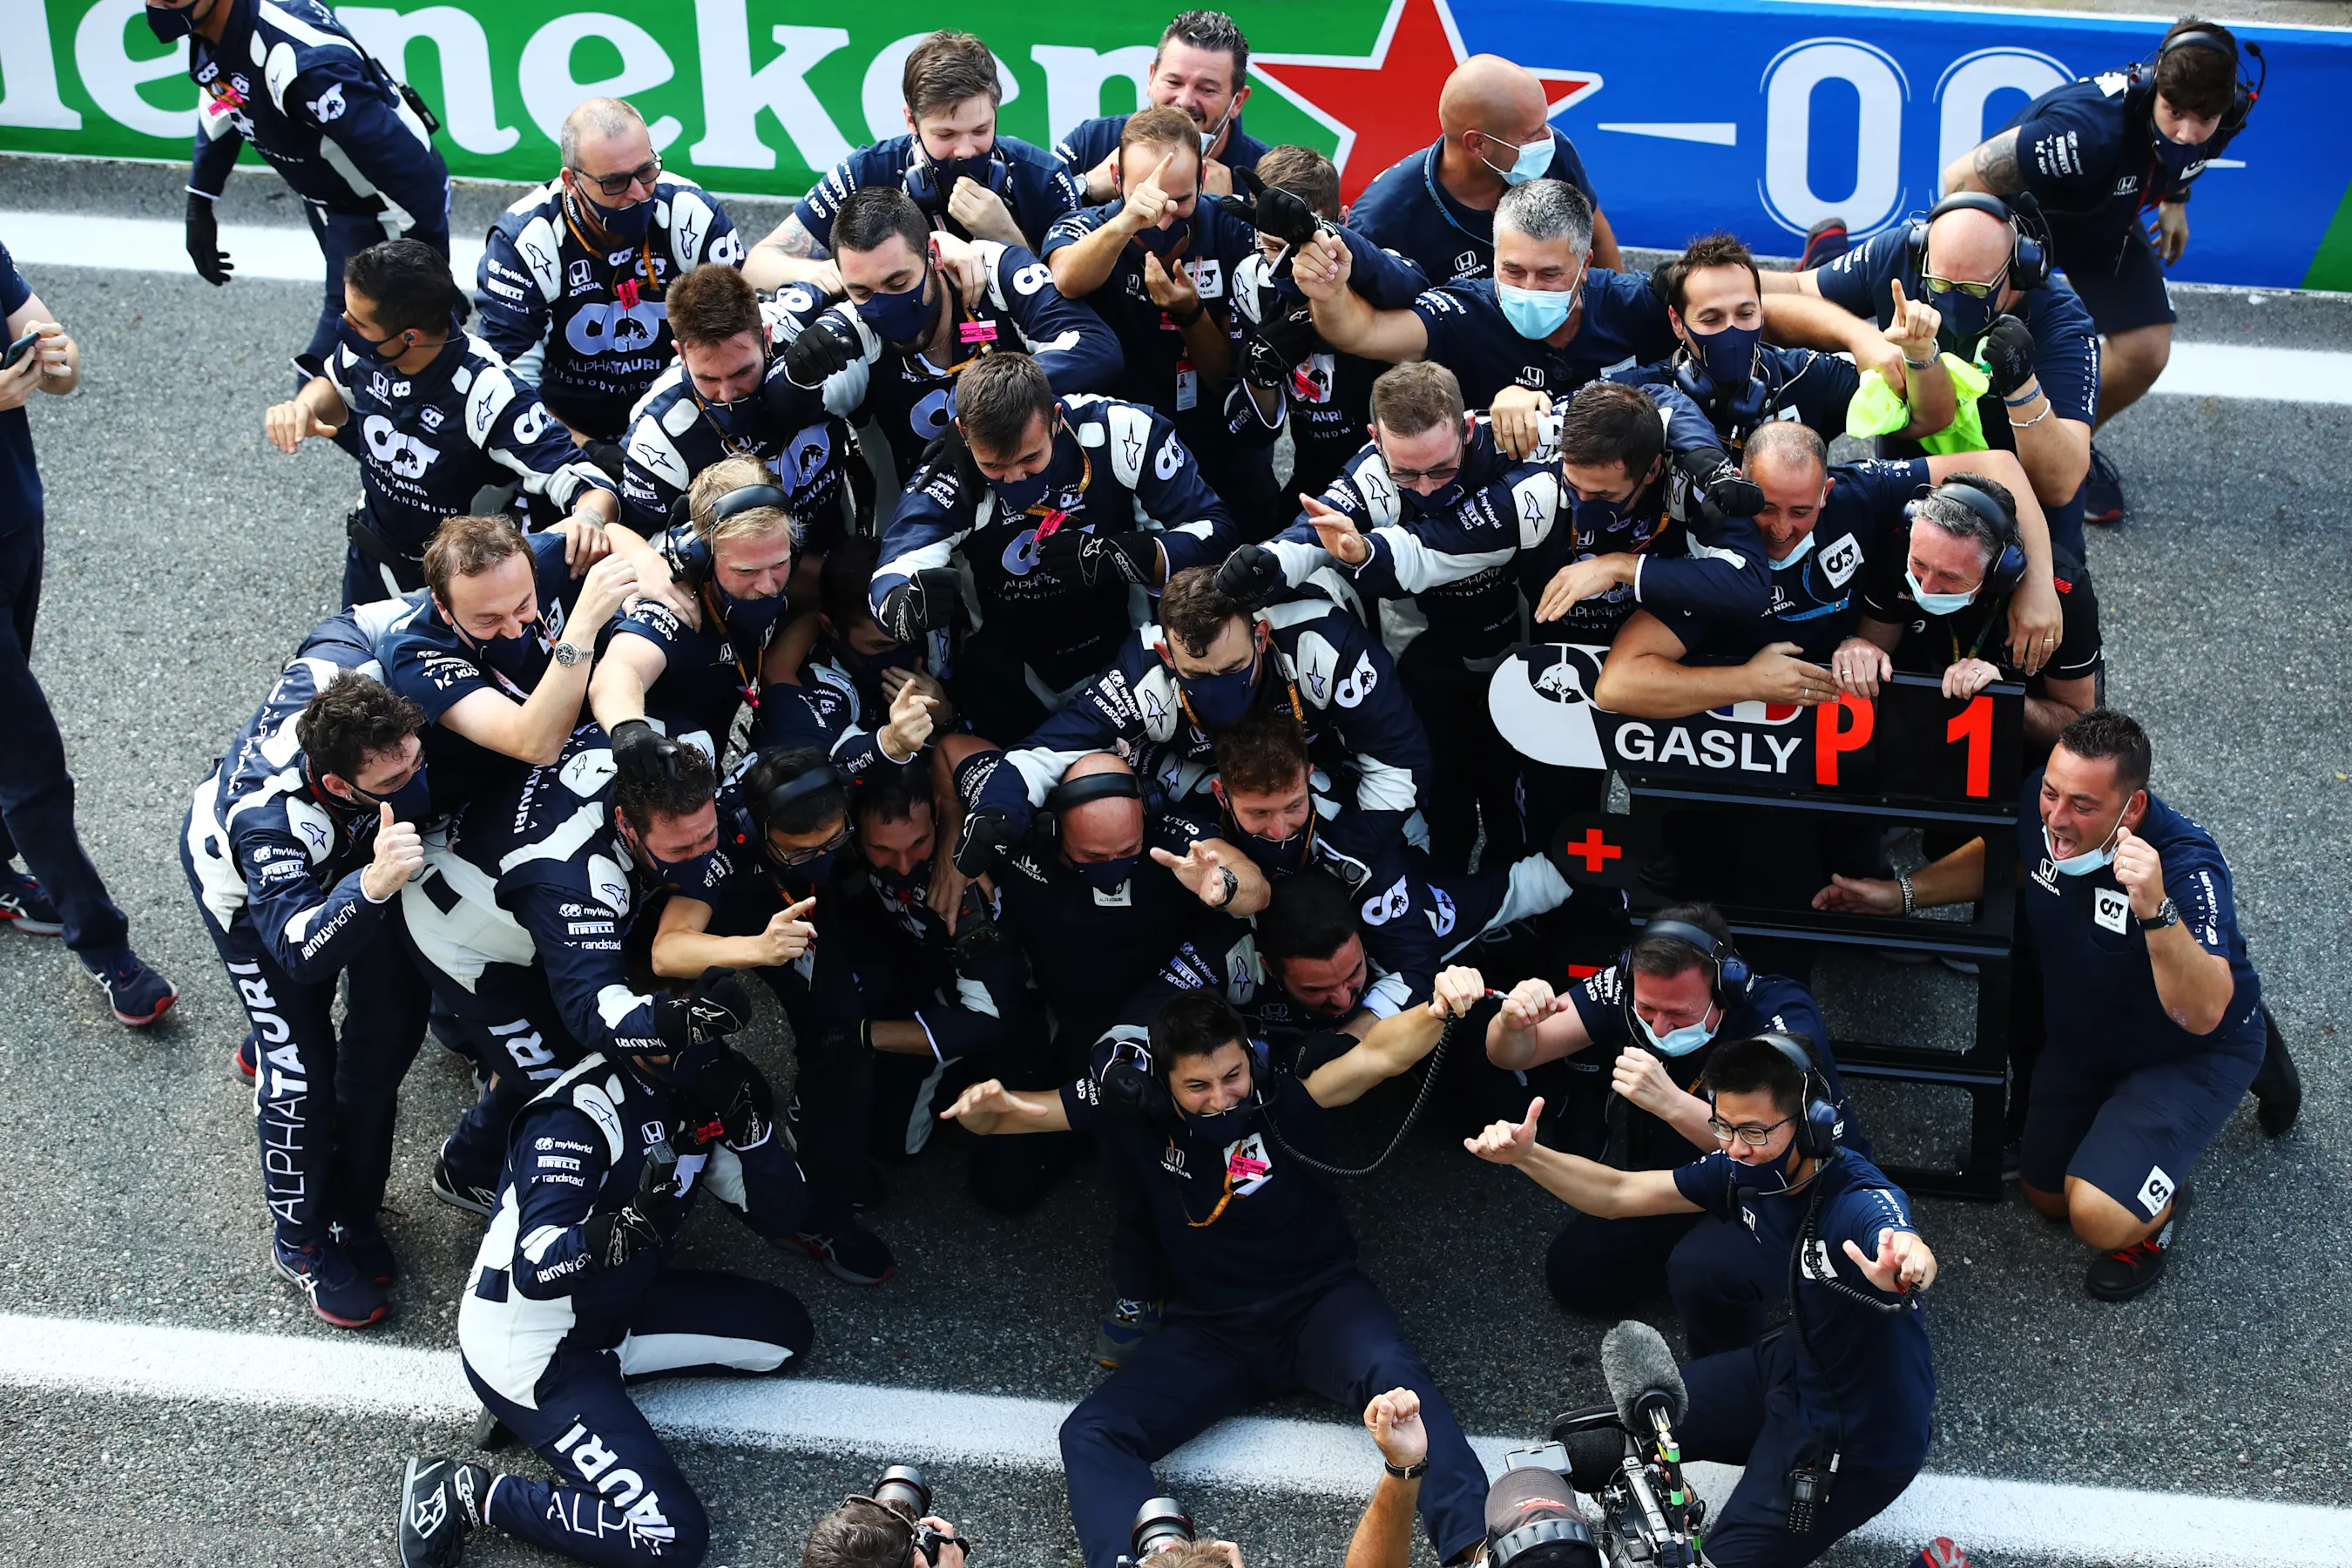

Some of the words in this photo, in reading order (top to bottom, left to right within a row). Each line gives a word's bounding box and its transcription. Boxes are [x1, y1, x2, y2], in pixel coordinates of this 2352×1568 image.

[499, 266, 534, 289] myWorld
[1449, 264, 1488, 281] HONDA
[568, 280, 604, 299] ONDA
[567, 358, 661, 375] ALPHATAURI
[1480, 495, 1503, 530] myWorld
[1098, 679, 1132, 718] PIRELLI
[1119, 686, 1143, 721] myWorld
[1092, 694, 1126, 730] randstad
[1614, 722, 1802, 774] GASLY
[1816, 691, 1876, 786] P
[1947, 696, 1994, 798] 1
[1011, 860, 1049, 884] HONDA
[2031, 870, 2061, 897] HONDA
[300, 900, 358, 961] ALPHATAURI
[567, 921, 616, 936] PIRELLI
[580, 938, 622, 950] randstad
[1165, 971, 1192, 990] randst
[1170, 956, 1205, 990] PIRELLI
[1191, 953, 1220, 985] myWorld
[1612, 979, 1624, 1006] World
[226, 961, 308, 1225] ALPHATAURI
[553, 1139, 594, 1154] myWorld
[537, 1155, 581, 1172] PIRELLI
[1159, 1159, 1193, 1180] ONDA
[542, 1173, 585, 1187] randstad
